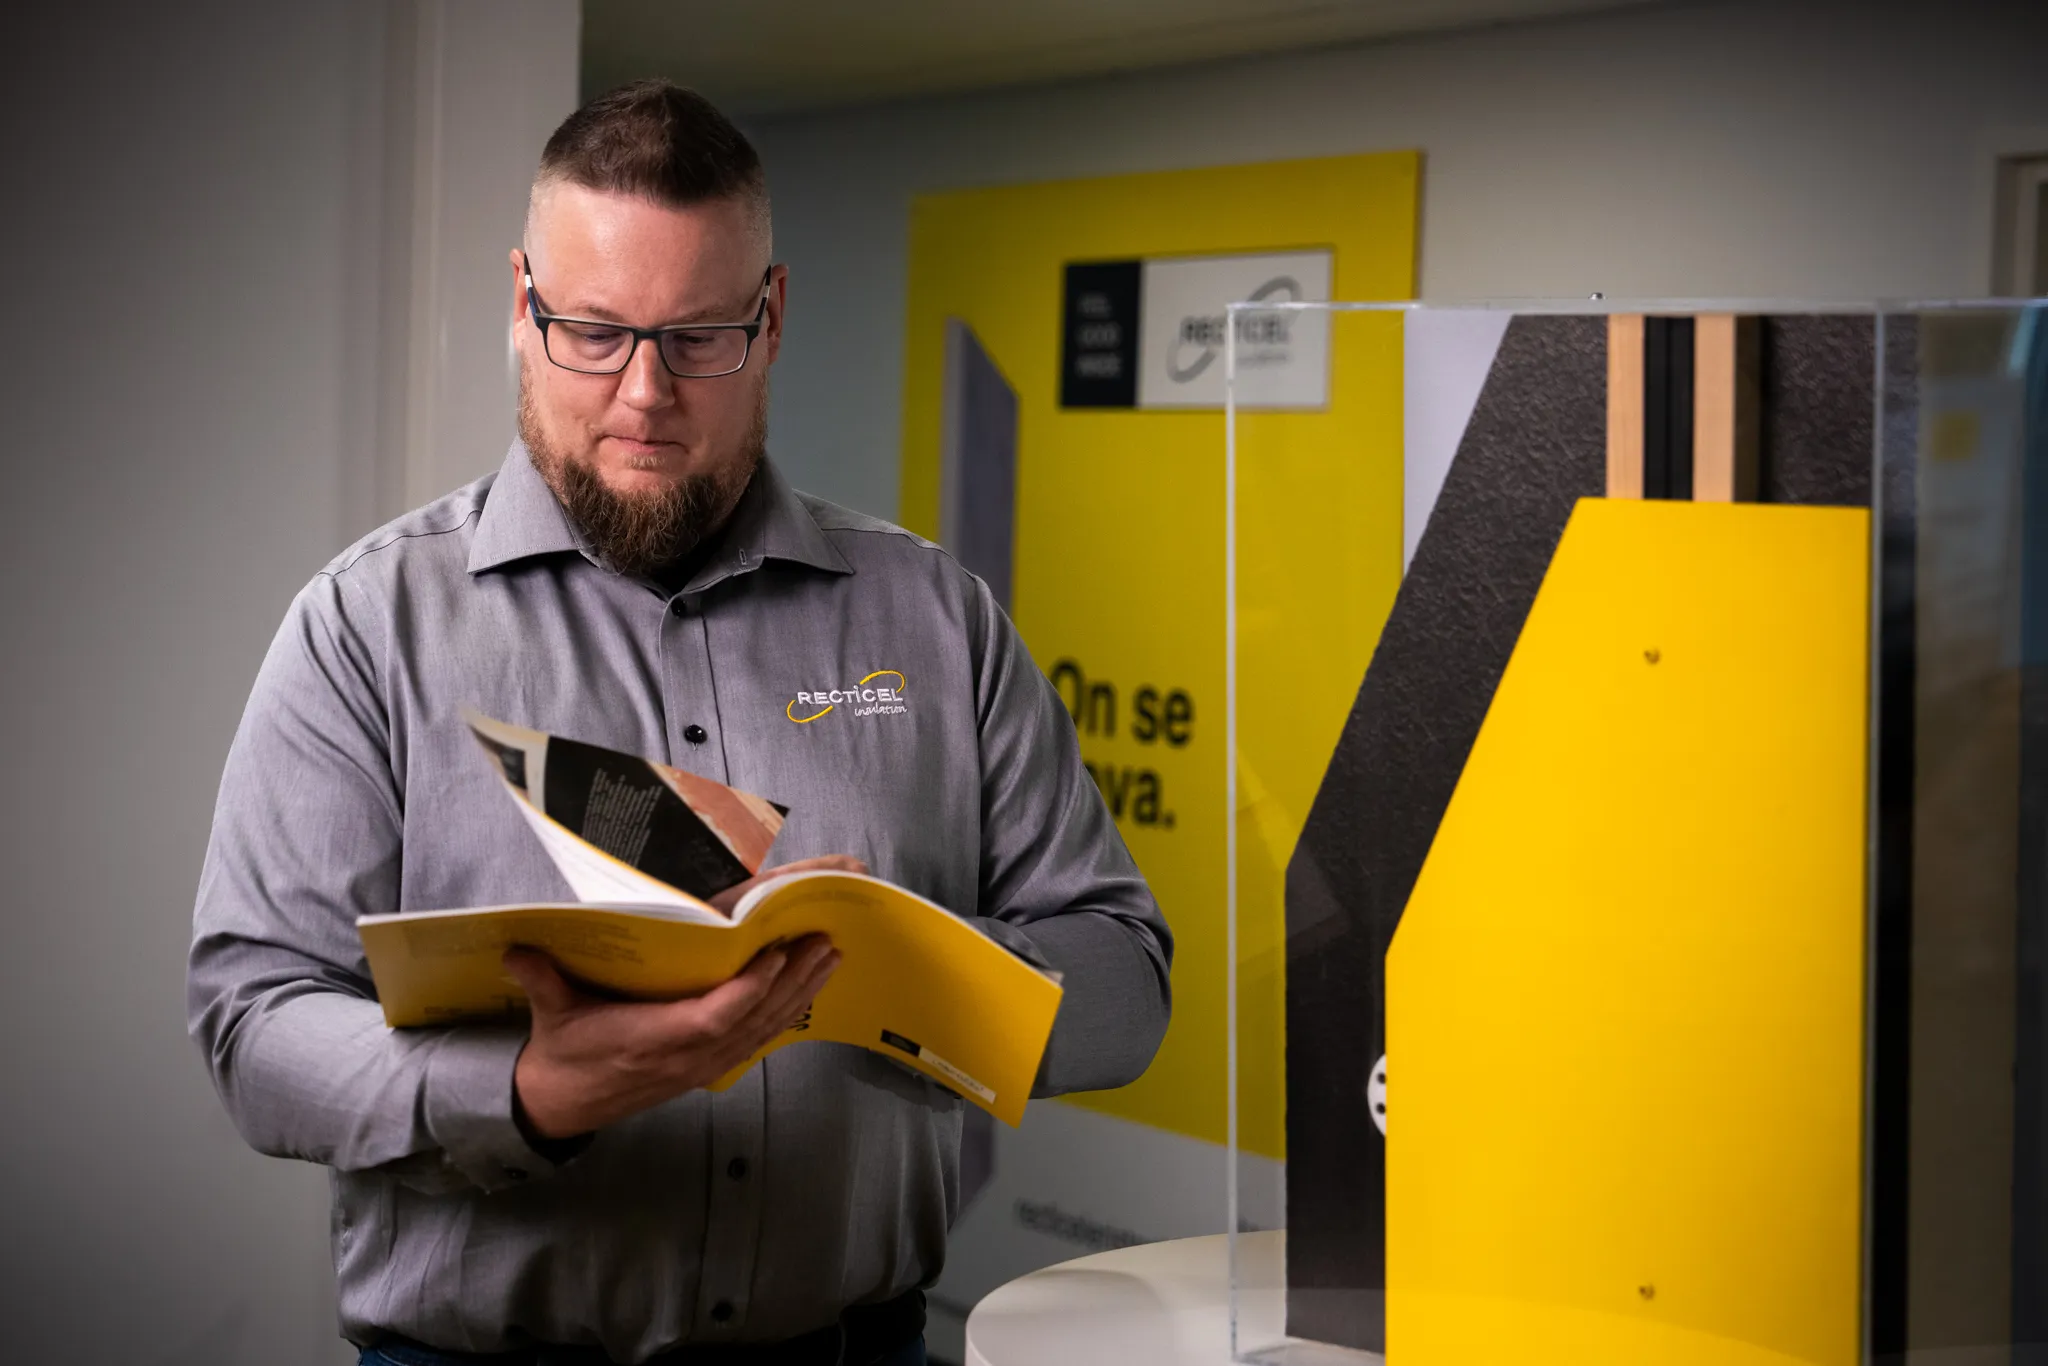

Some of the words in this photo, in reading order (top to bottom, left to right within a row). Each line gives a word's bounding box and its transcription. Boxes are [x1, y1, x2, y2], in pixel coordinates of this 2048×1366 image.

[854, 702, 908, 717] insulation
[1050, 657, 1118, 737] On
[1131, 685, 1195, 746] se
[1084, 760, 1177, 829] va.
